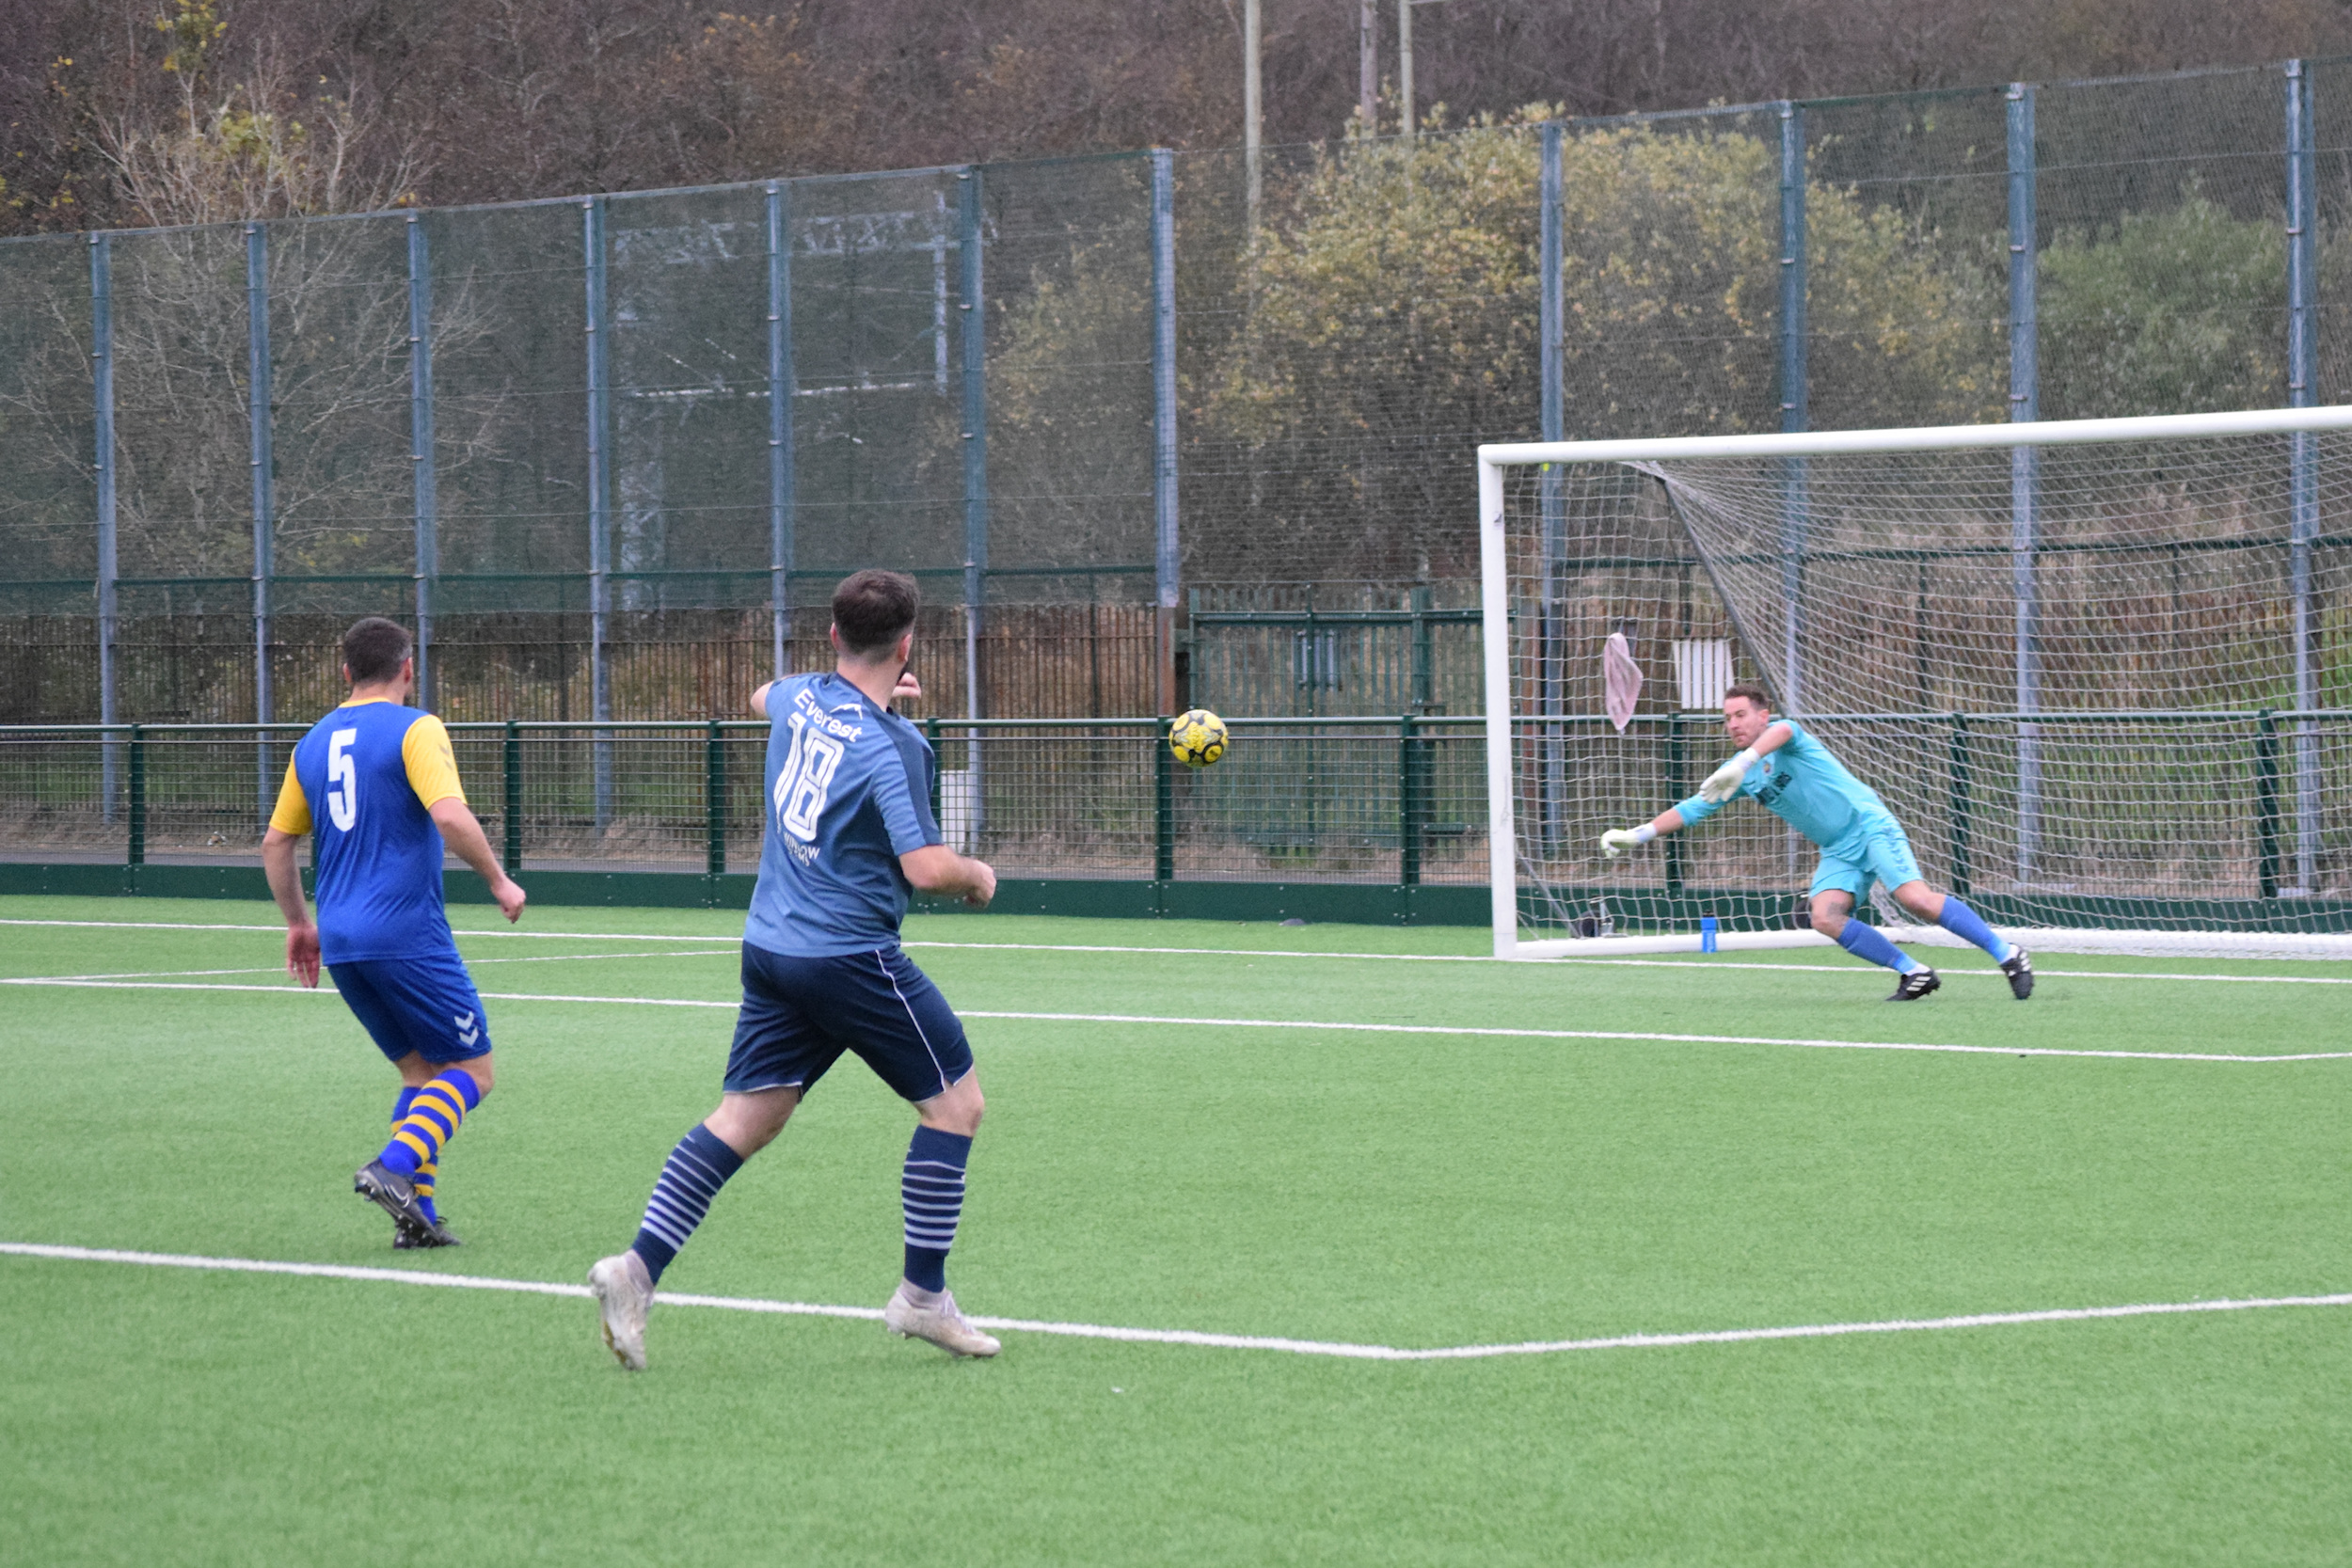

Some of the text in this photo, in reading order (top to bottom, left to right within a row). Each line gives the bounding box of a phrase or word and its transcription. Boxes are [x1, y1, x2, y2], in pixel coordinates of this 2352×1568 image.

[795, 689, 862, 742] Everest
[328, 728, 357, 832] 5
[774, 712, 844, 841] 18
